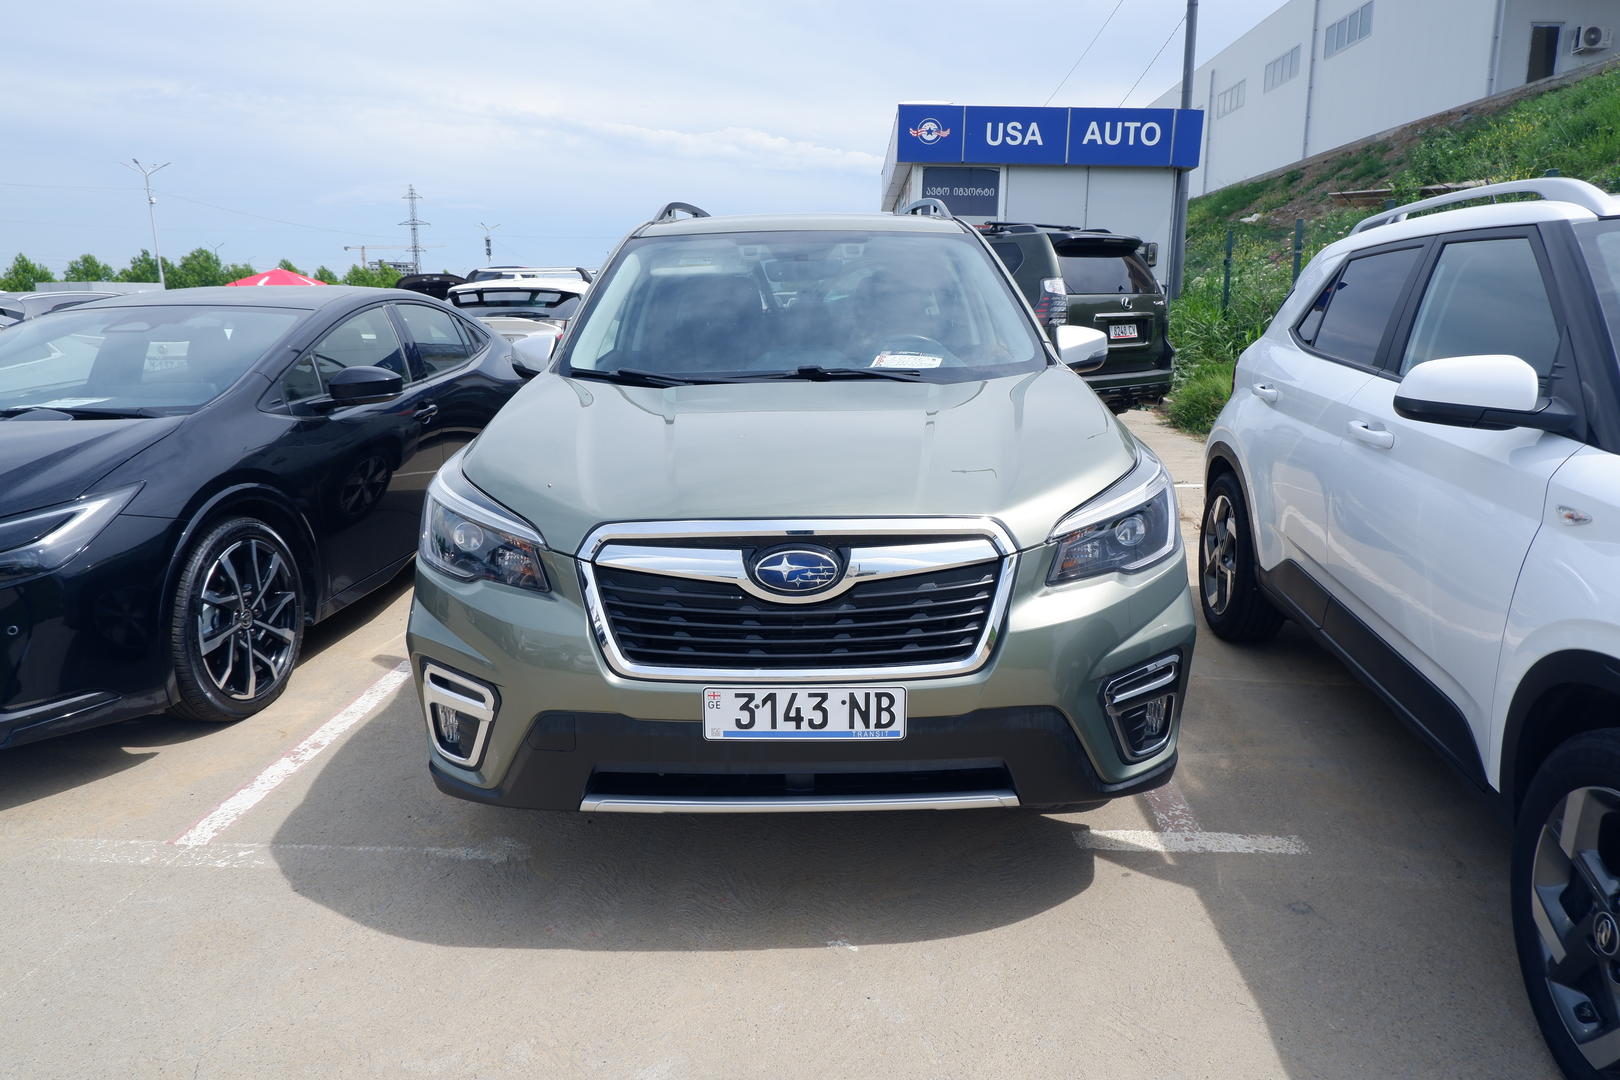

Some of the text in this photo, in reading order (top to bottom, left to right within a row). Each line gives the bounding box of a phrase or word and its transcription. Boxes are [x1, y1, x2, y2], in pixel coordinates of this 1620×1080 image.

[985, 121, 1161, 146] USA AUTO
[926, 187, 995, 197] ავტო იმპორტი
[707, 700, 721, 710] GE
[734, 692, 896, 730] 3143 NB
